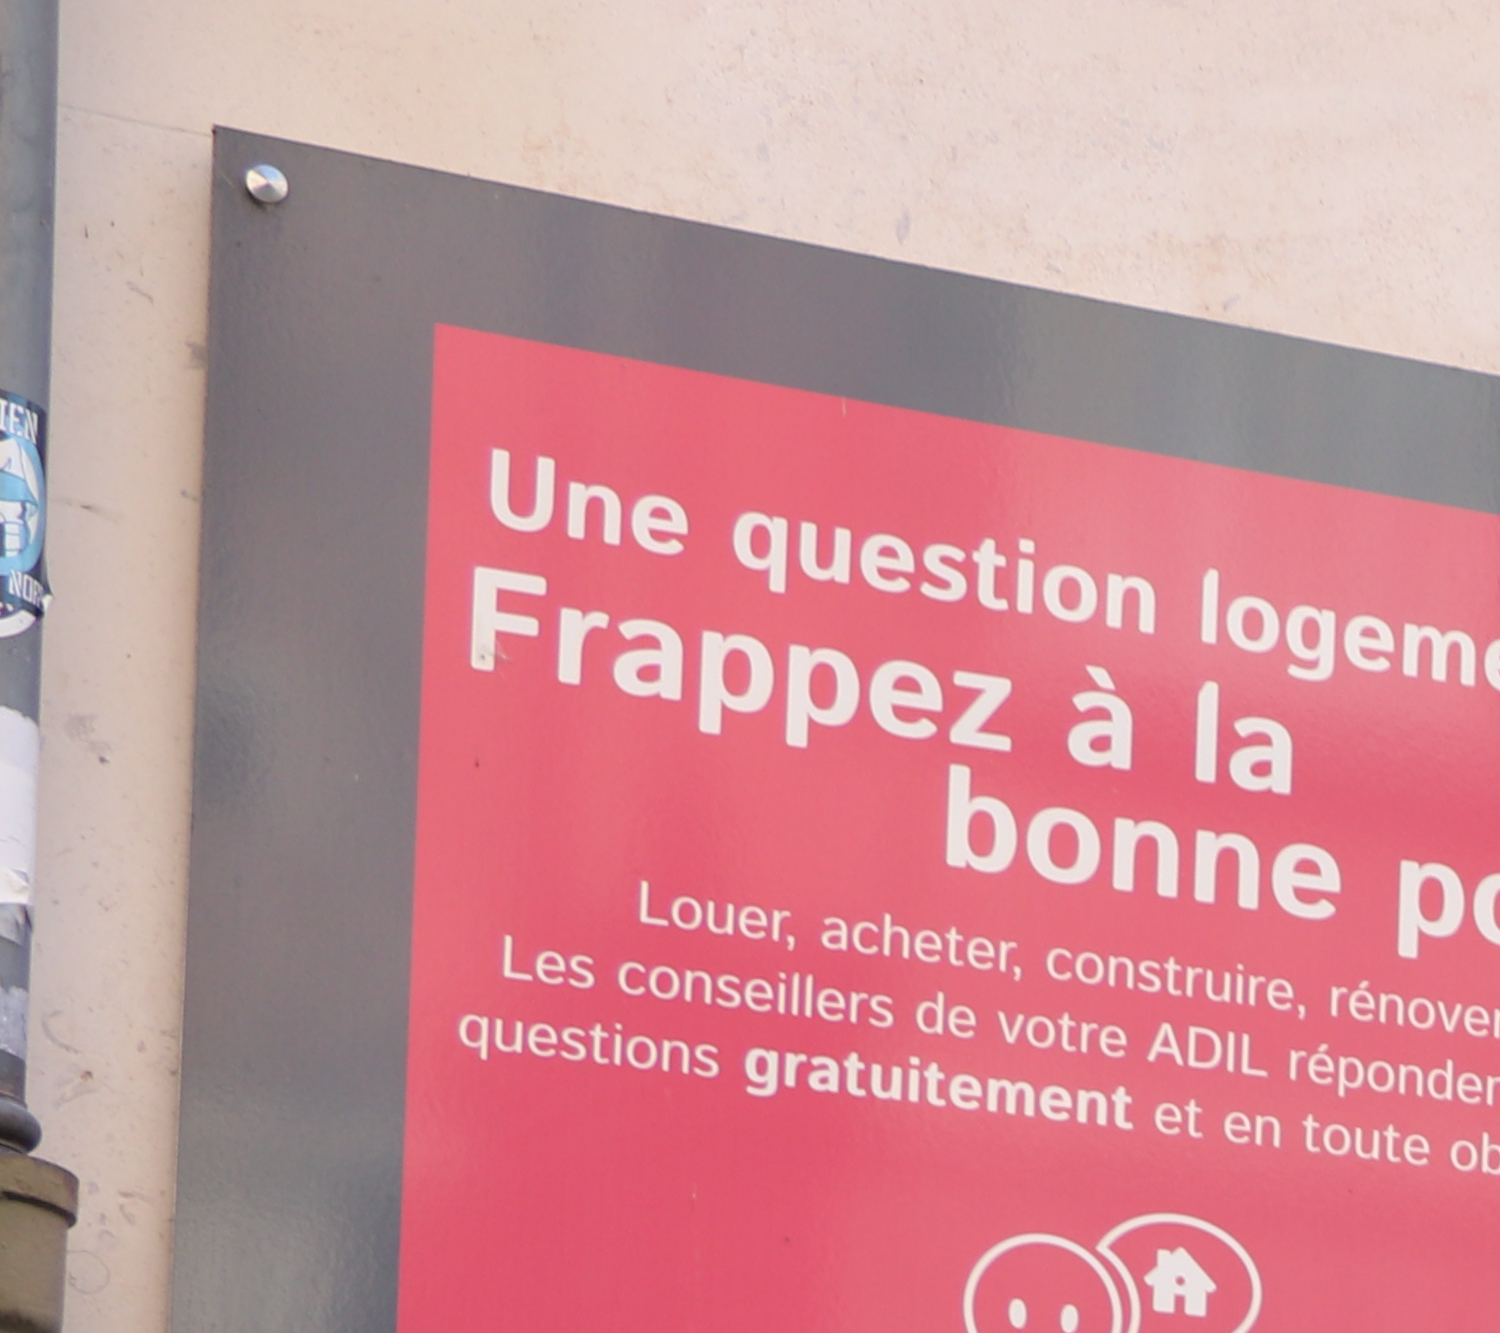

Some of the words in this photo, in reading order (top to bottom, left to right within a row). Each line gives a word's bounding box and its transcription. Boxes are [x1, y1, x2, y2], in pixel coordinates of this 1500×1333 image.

[488, 446, 690, 556] Une
[731, 510, 1158, 636] question
[469, 564, 1014, 753] Frappez
[1066, 663, 1134, 771] à
[1193, 678, 1294, 796] la
[944, 762, 1343, 921] bonne
[502, 933, 596, 990] Les
[617, 960, 895, 1029] conseillers
[914, 990, 978, 1040] de
[996, 1009, 1129, 1059] votre
[1145, 1021, 1269, 1078] ADIL
[638, 879, 796, 952] Louer,
[819, 912, 1023, 983] acheter,
[1045, 946, 1307, 1021] construire,
[457, 1013, 720, 1078] questions
[743, 1047, 1135, 1132] gratuitement
[1153, 1097, 1204, 1140] et
[1222, 1110, 1282, 1149] en
[1300, 1112, 1432, 1167] toute
